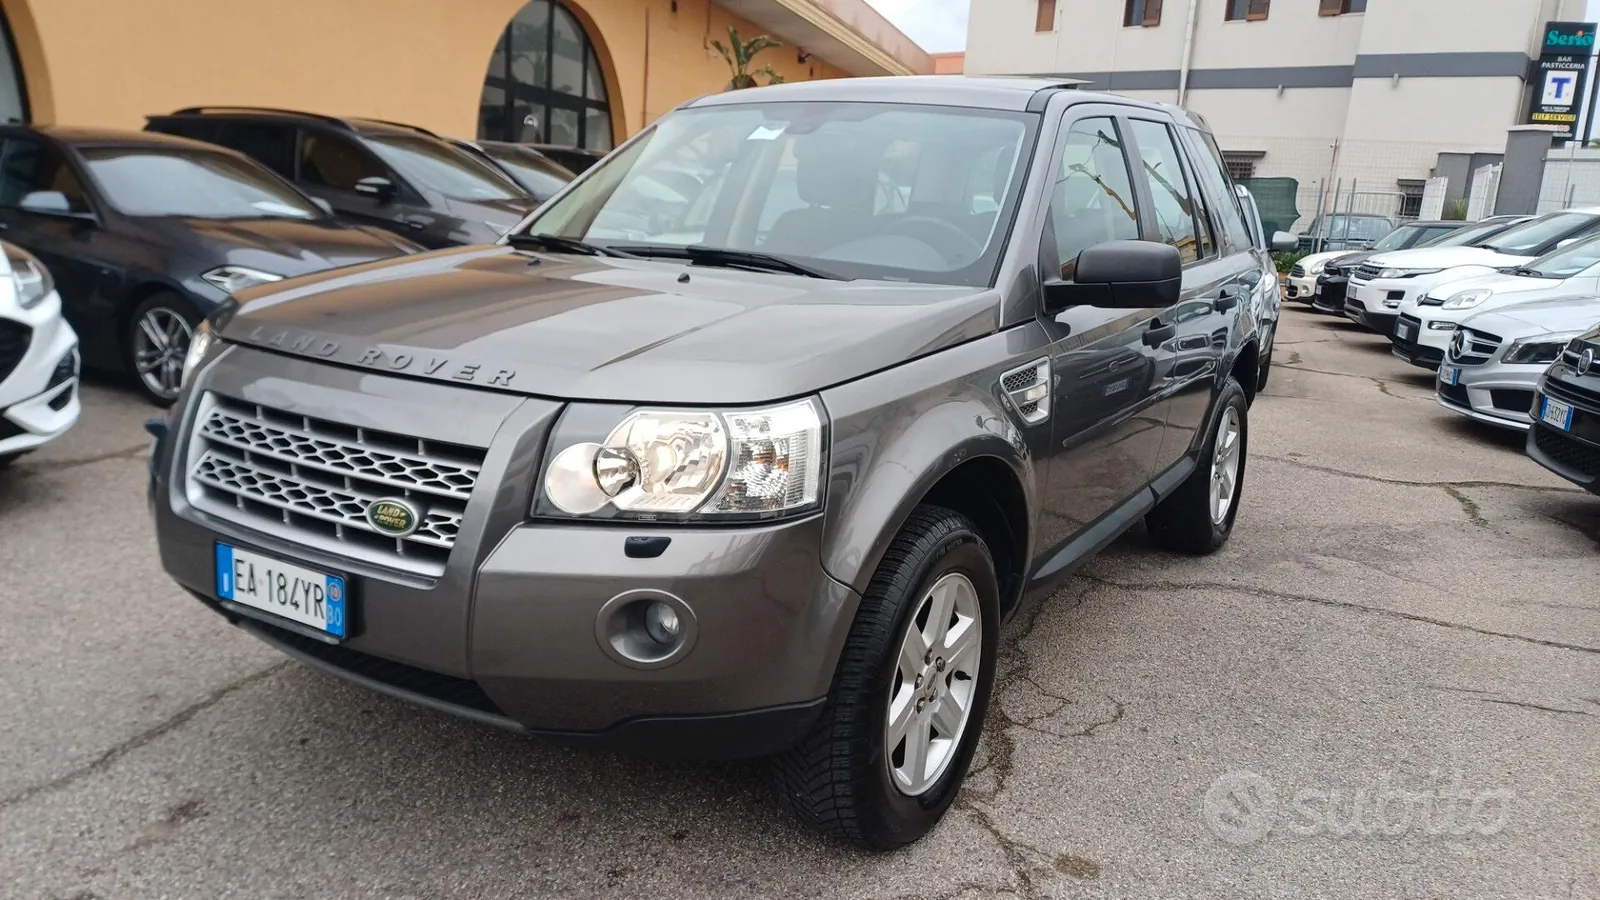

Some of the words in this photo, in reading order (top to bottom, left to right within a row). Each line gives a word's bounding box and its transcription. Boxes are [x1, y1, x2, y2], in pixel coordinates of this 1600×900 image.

[1551, 77, 1572, 99] T
[249, 326, 341, 359] LAND
[357, 347, 516, 387] ROVER
[376, 505, 401, 517] LAND
[378, 514, 407, 528] ROVER
